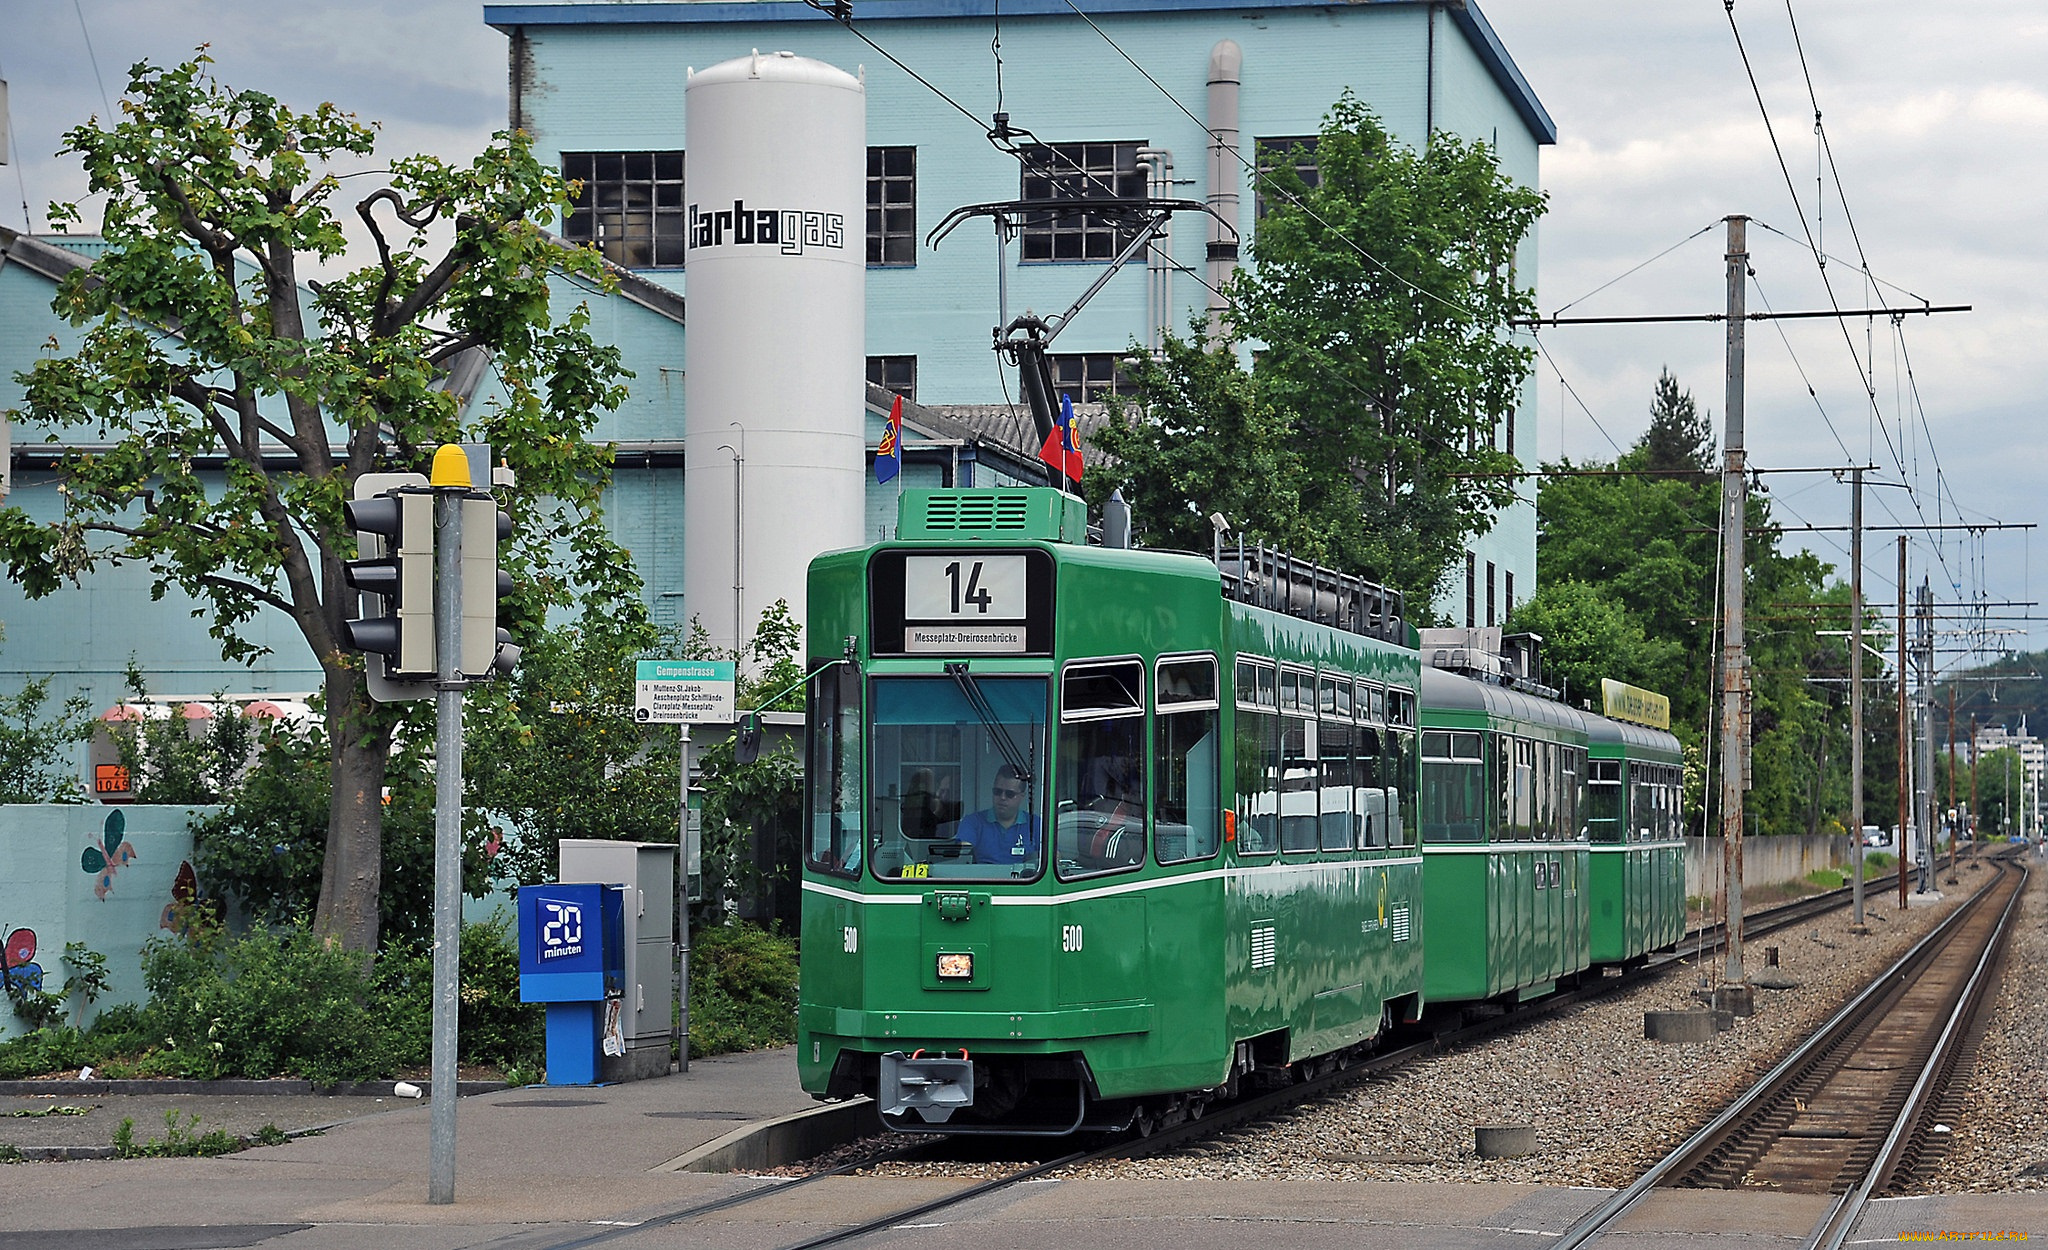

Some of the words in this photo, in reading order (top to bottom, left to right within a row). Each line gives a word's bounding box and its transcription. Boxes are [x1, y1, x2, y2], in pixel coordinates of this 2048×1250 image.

[944, 561, 993, 614] 14
[914, 632, 1018, 643] Messeplatz-Dreirosenbrücke
[656, 665, 715, 677] Gempenstrasse
[641, 684, 649, 692] 14
[653, 711, 698, 719] Dreirosenbrücke
[98, 780, 129, 790] 1049
[918, 867, 924, 876] 2
[543, 904, 582, 945] 20
[843, 926, 858, 953] 500
[1062, 924, 1083, 952] 500
[544, 945, 582, 959] minuten
